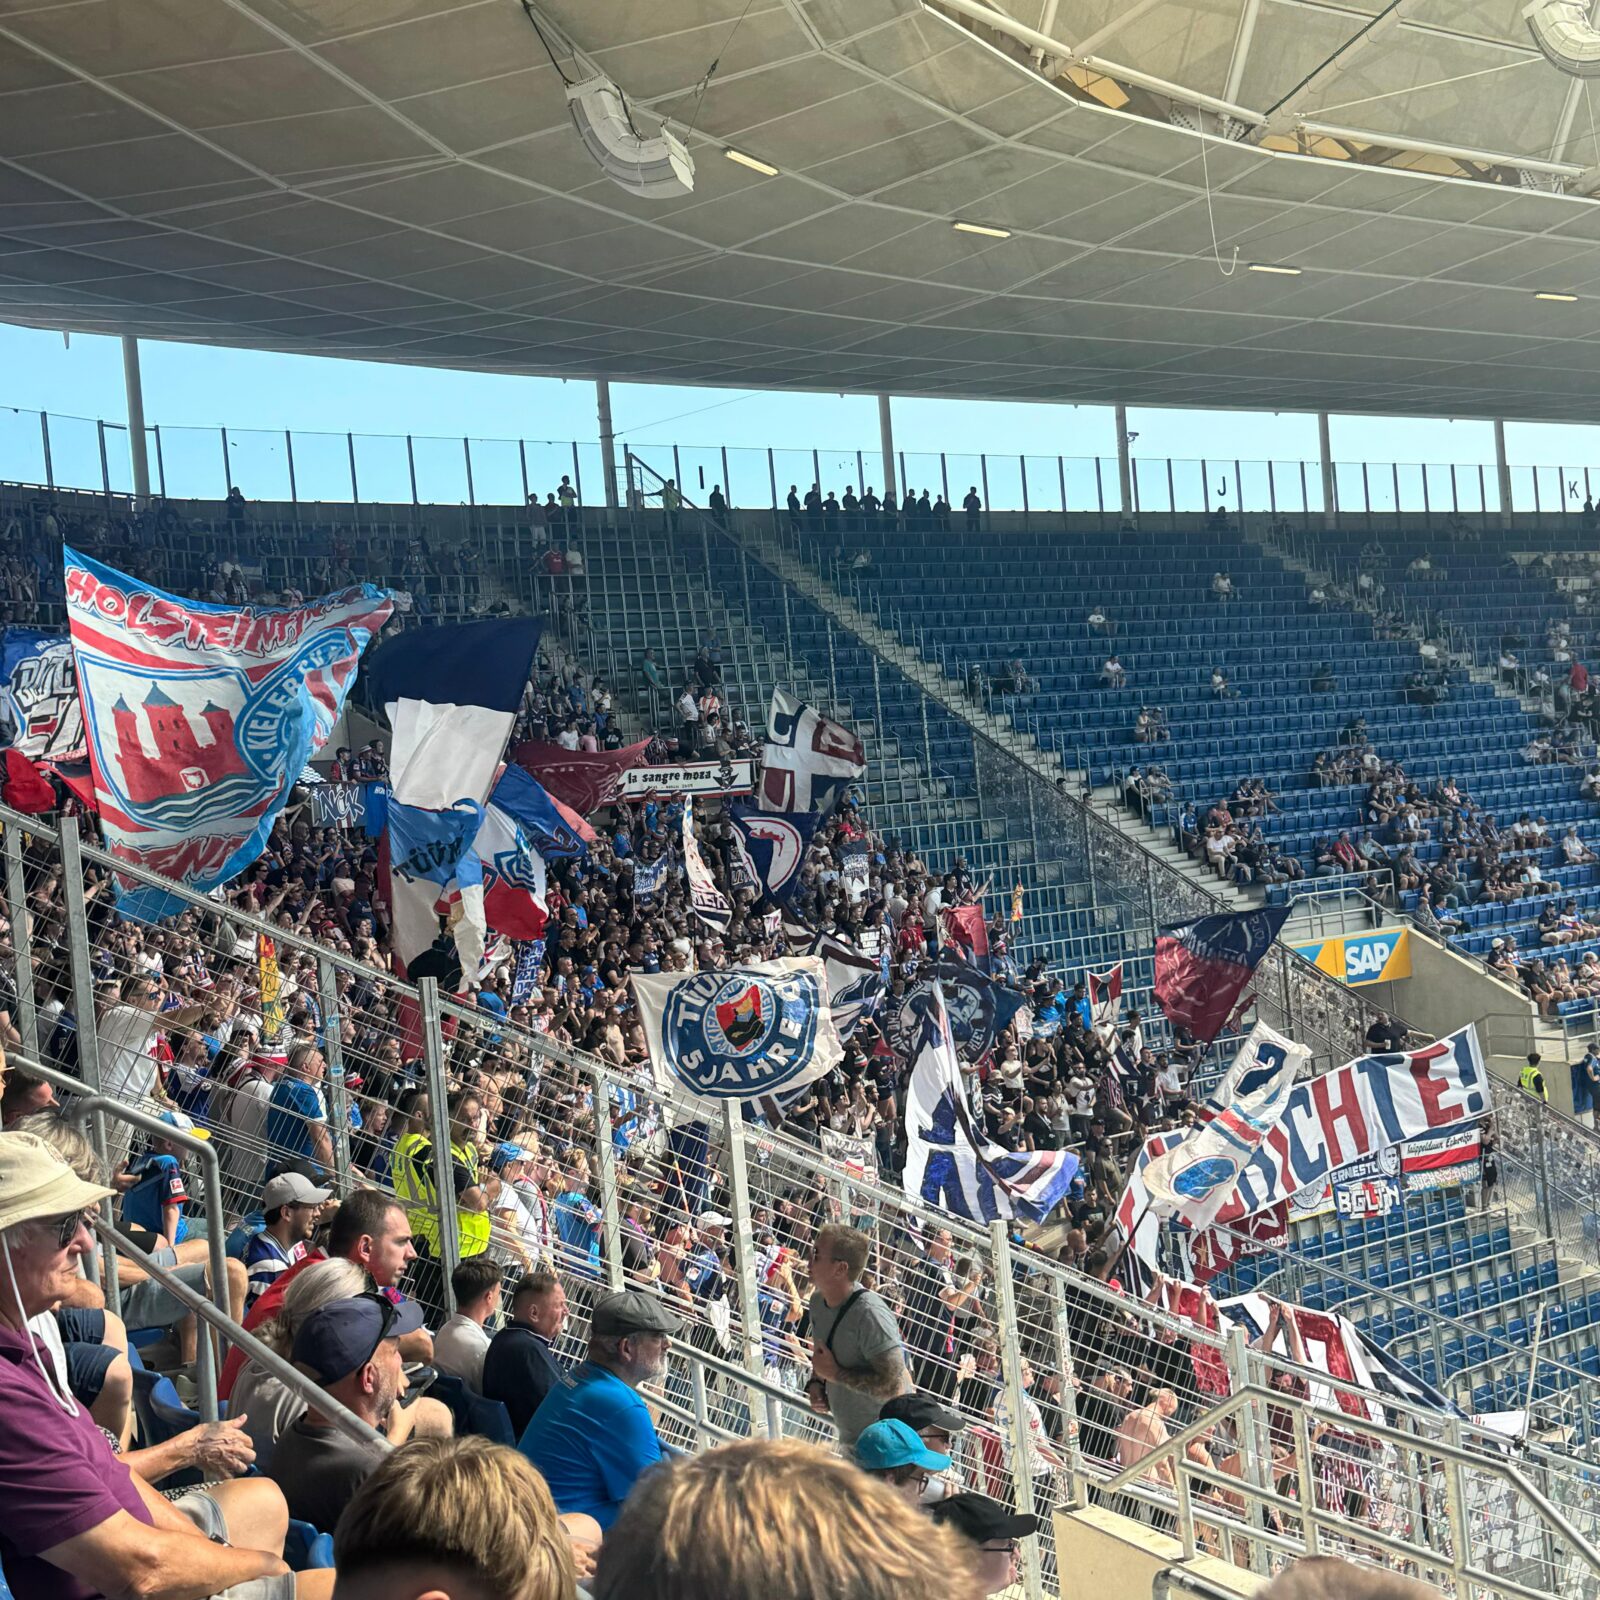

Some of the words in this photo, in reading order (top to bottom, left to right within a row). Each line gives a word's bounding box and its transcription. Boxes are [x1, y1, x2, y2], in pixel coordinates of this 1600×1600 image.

[1217, 475, 1227, 497] J
[1568, 480, 1580, 499] K
[628, 772, 638, 784] la
[642, 771, 681, 785] sangre
[683, 769, 711, 781] moza
[1345, 942, 1390, 976] SAP
